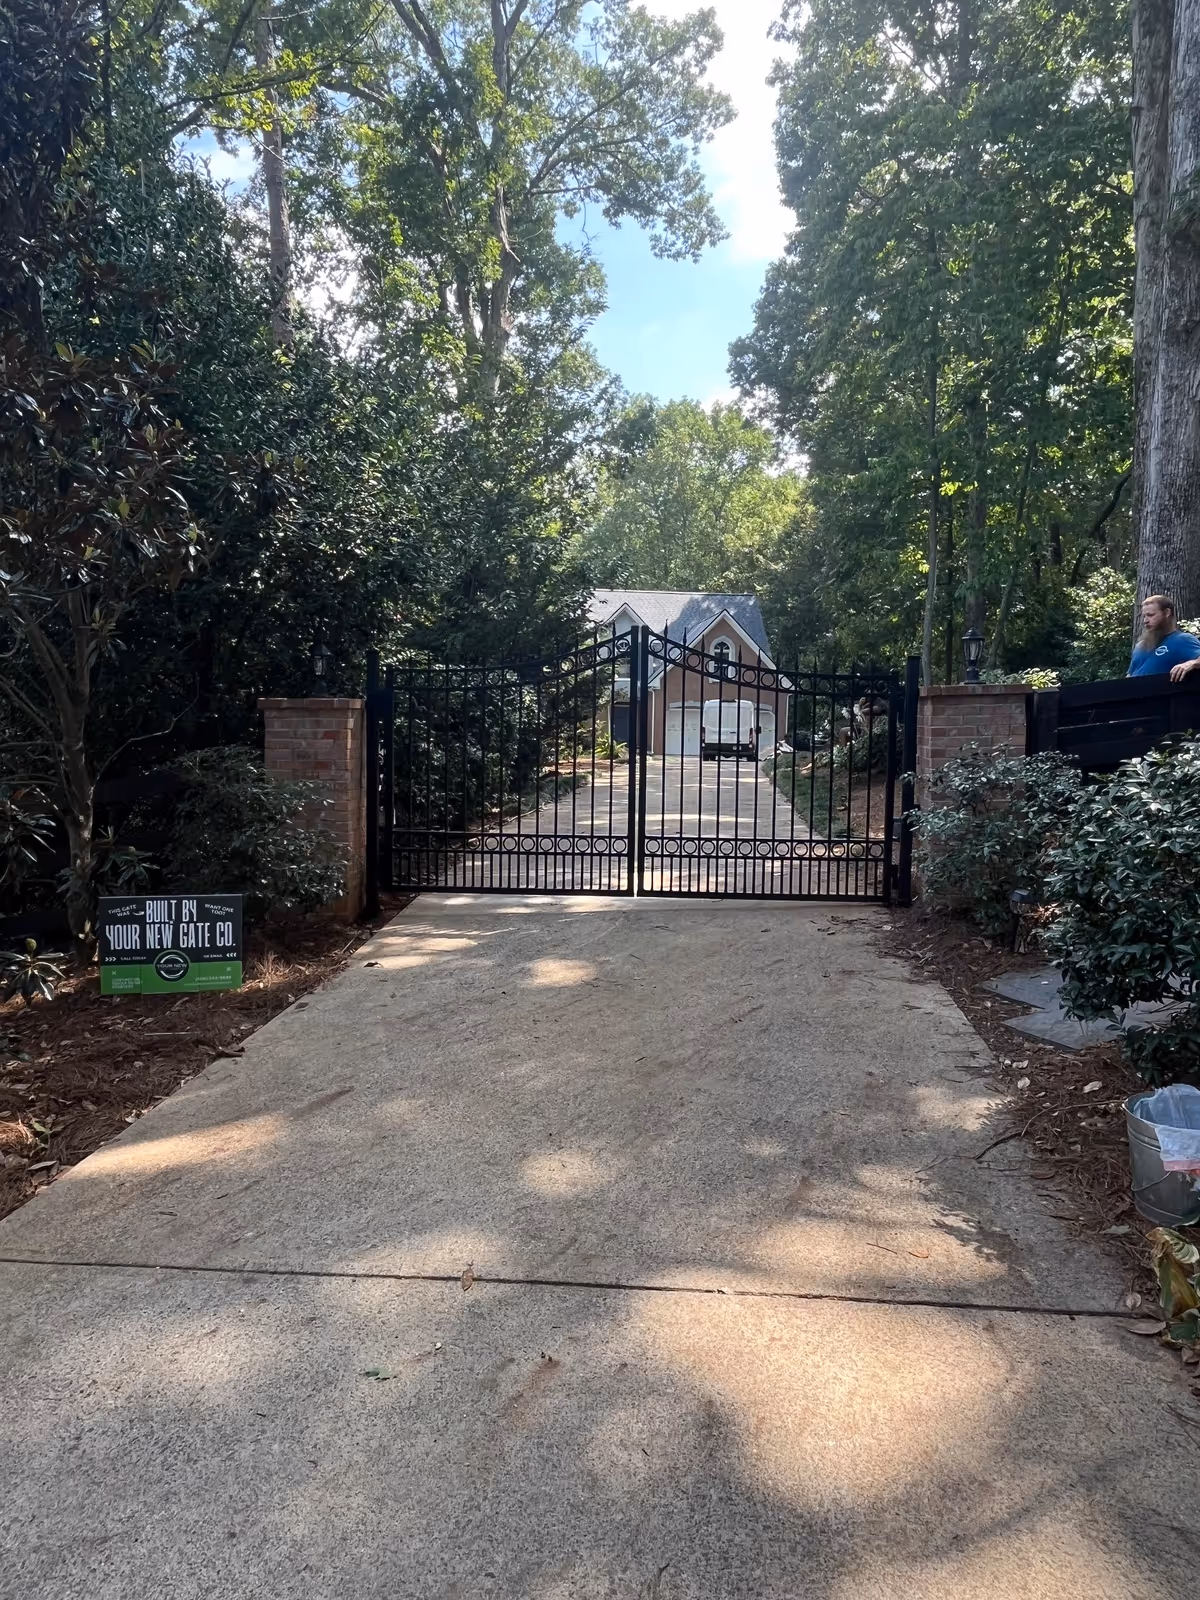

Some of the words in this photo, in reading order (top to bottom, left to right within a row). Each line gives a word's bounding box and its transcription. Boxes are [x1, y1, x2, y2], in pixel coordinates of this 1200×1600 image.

[121, 904, 137, 912] GATE
[146, 900, 177, 923] BUILT
[182, 899, 197, 922] BY
[105, 924, 140, 950] YOUR
[146, 922, 173, 949] NEW
[179, 922, 210, 948] GATE
[216, 921, 236, 947] CO.
